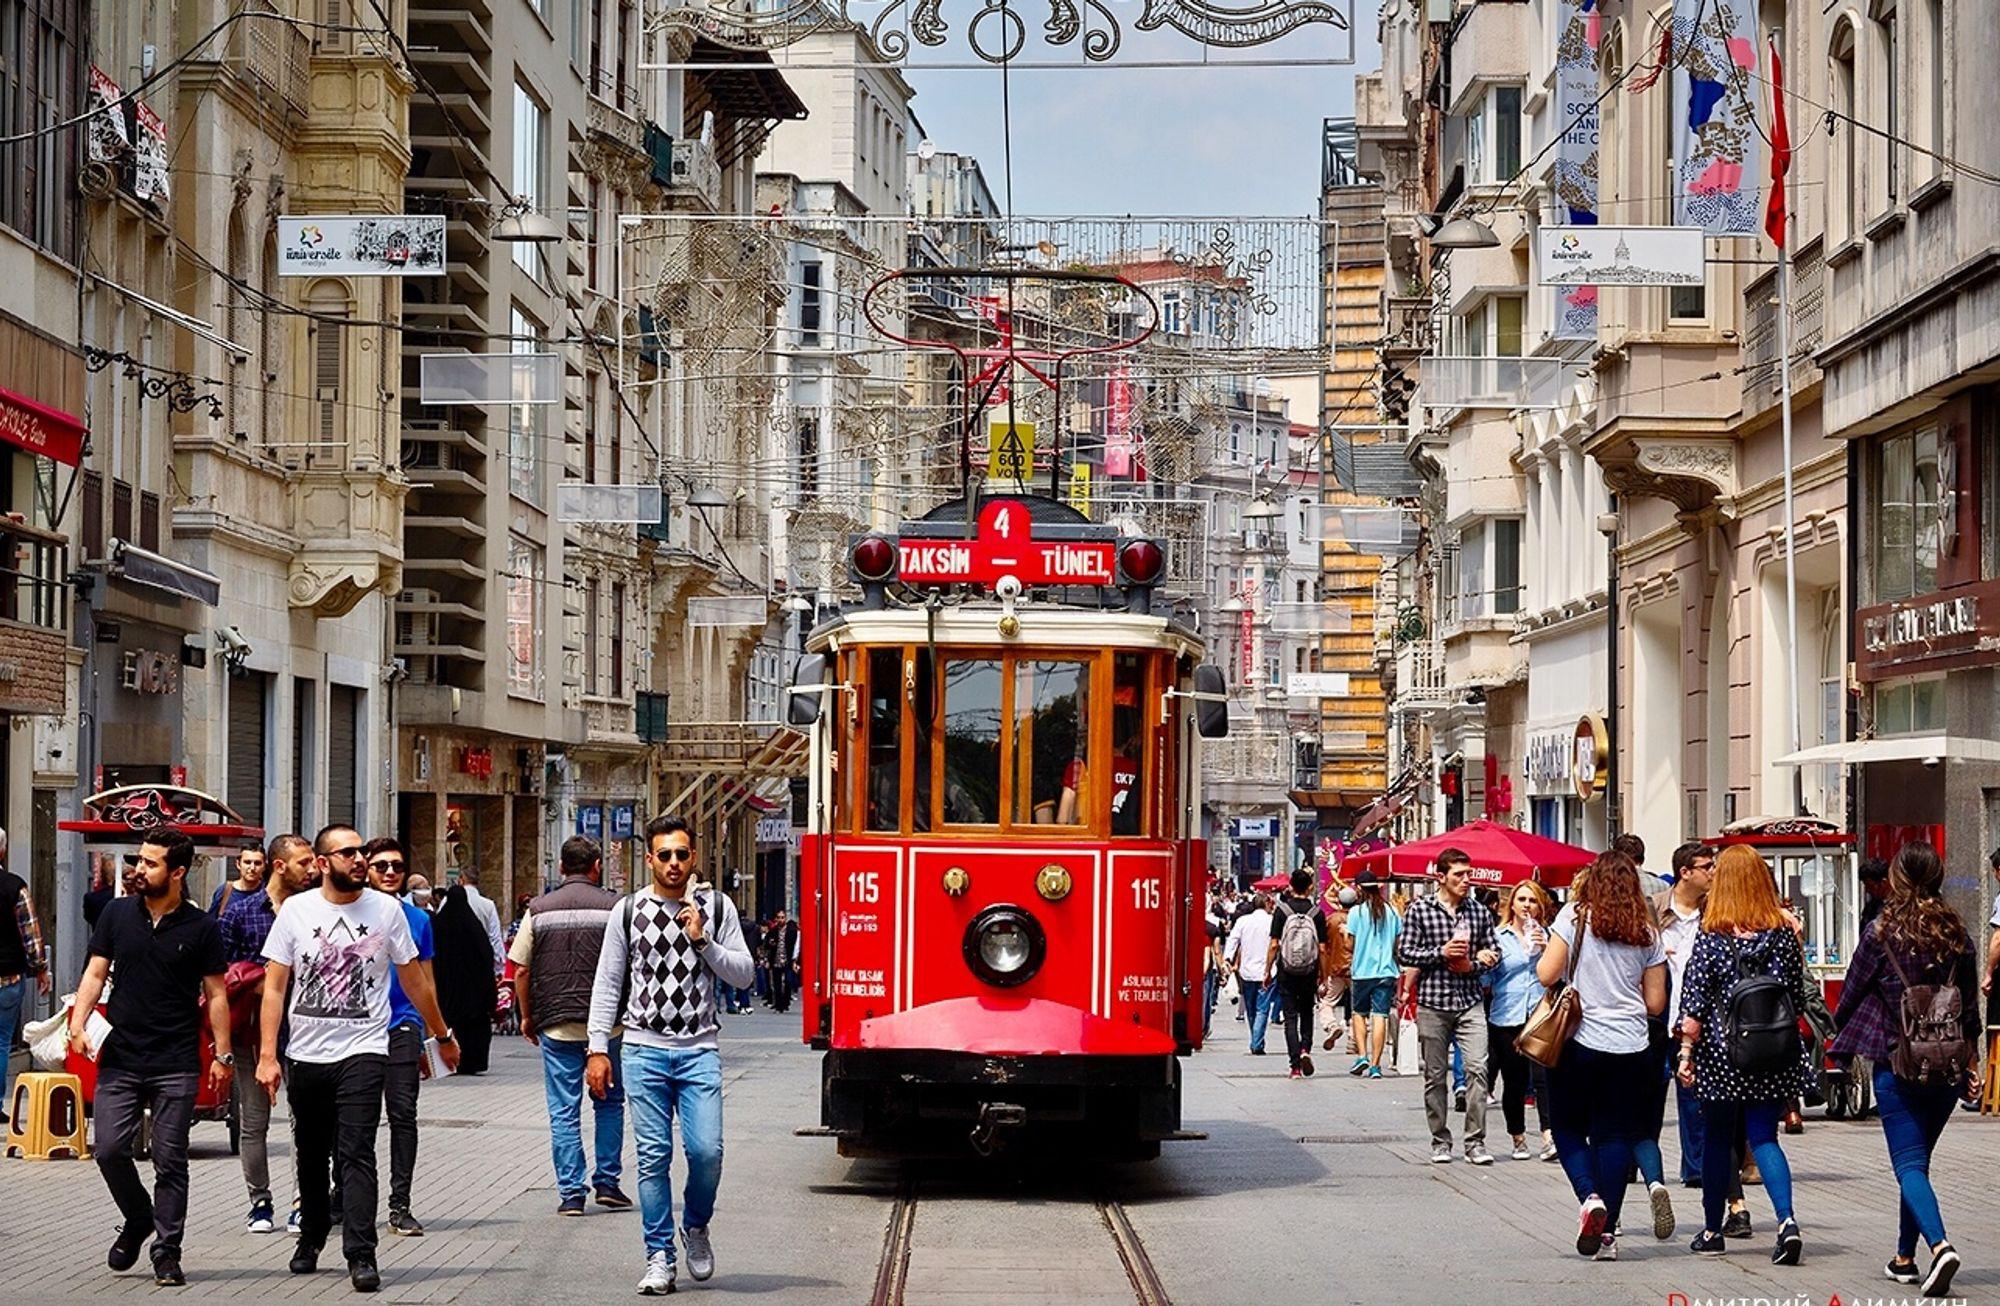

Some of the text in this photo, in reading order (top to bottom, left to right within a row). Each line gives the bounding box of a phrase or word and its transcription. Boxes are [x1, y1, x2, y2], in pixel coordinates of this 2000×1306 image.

[998, 454, 1025, 466] 600
[993, 507, 1010, 538] 4
[899, 543, 971, 575] TAKSİM
[848, 871, 879, 904] 115
[1131, 878, 1160, 909] 115
